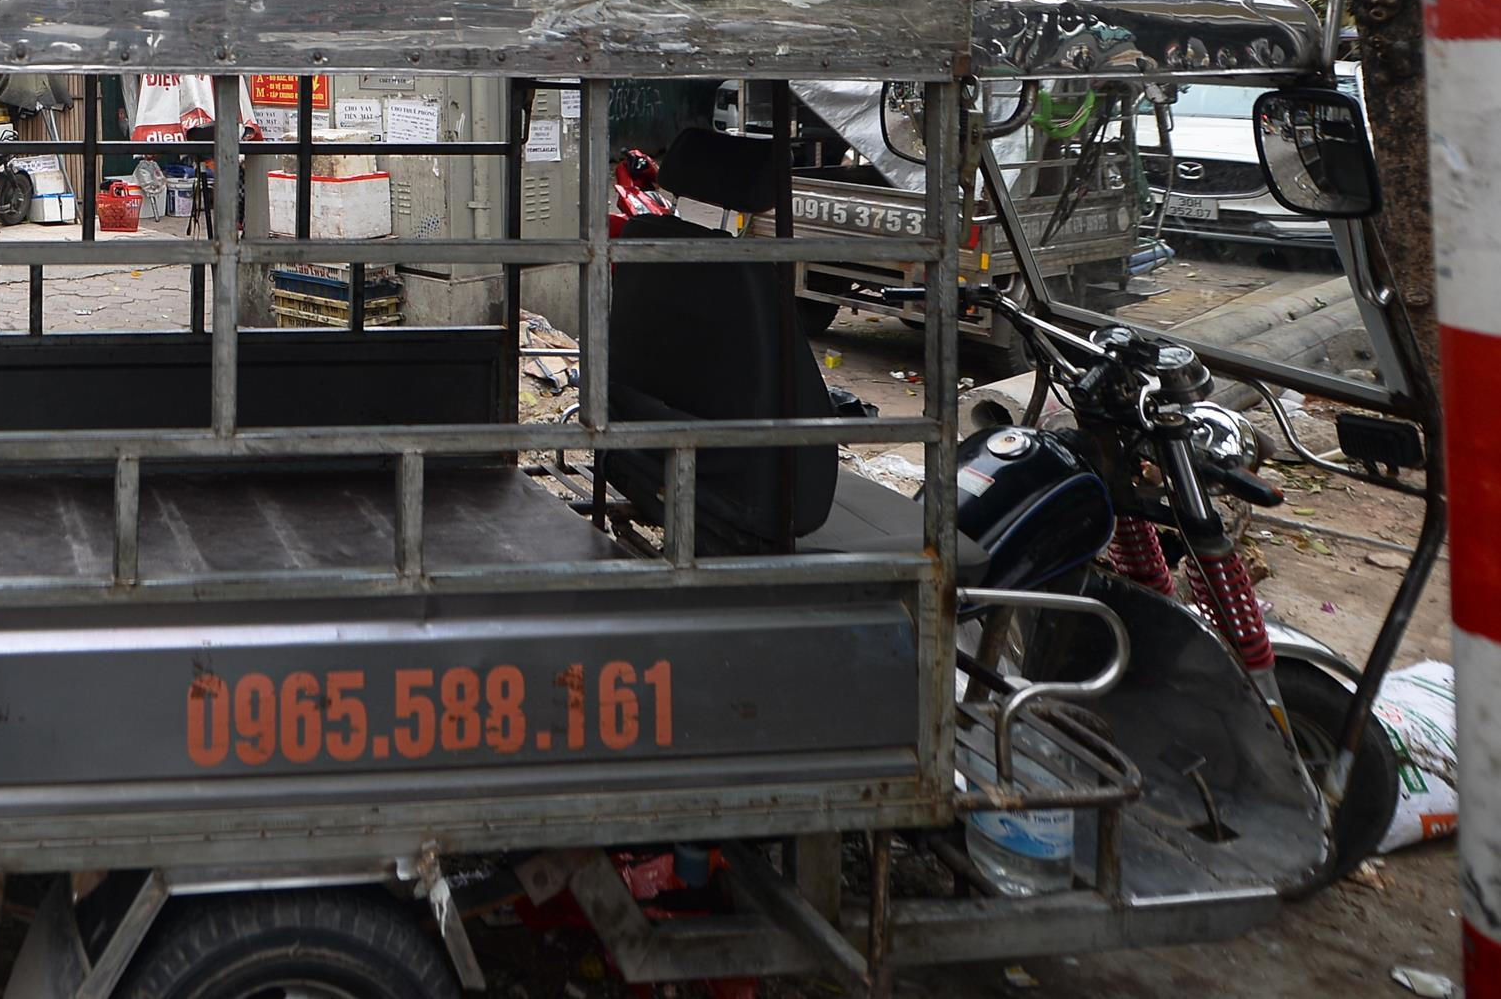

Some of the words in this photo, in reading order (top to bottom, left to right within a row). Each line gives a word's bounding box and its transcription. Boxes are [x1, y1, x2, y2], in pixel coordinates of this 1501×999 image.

[792, 196, 847, 224] 0915
[855, 206, 902, 232] 375
[905, 212, 926, 235] 3
[186, 659, 673, 768] 0965.588.161
